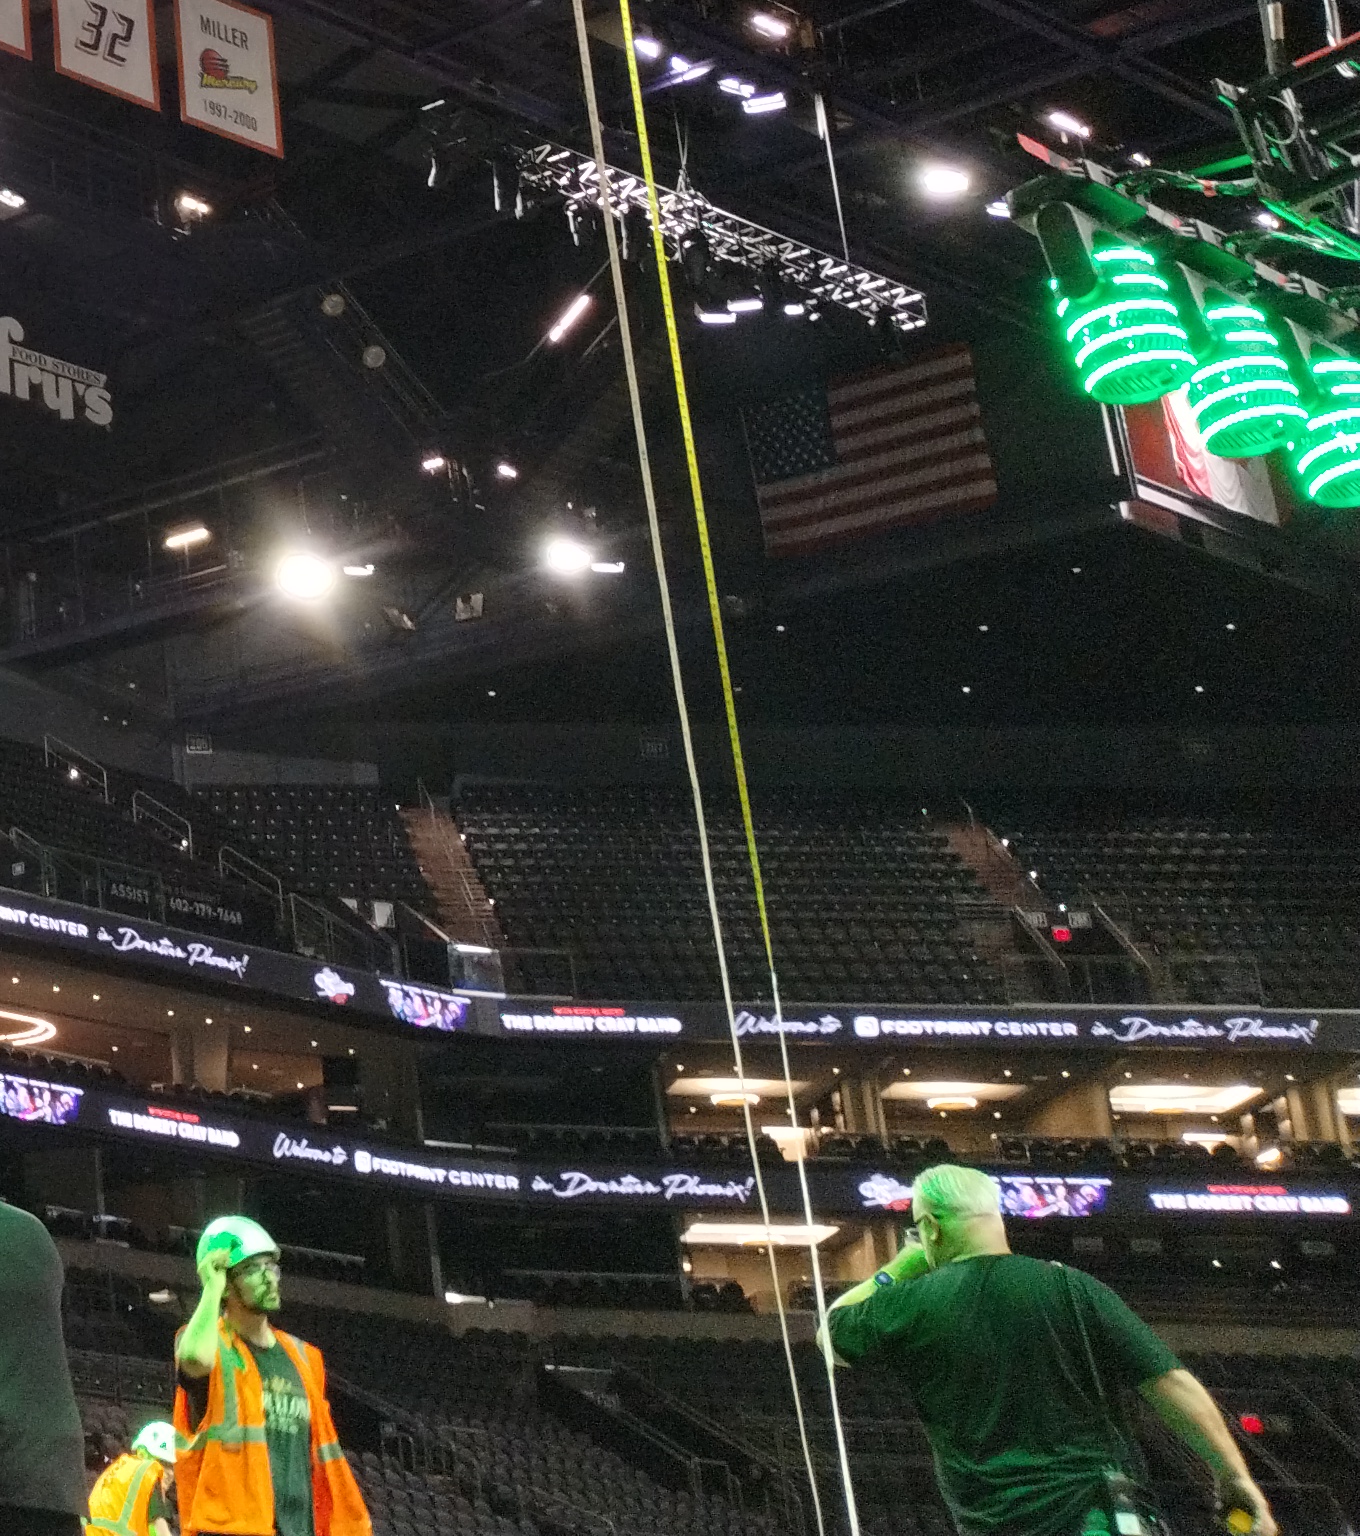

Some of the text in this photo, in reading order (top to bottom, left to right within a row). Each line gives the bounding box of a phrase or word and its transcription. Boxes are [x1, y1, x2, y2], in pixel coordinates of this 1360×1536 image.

[200, 15, 249, 50] MILLER
[203, 99, 258, 132] 1997-2000
[11, 345, 102, 385] FOOD STORES
[29, 913, 89, 938] CENTER
[501, 1013, 534, 1031] THE
[880, 1019, 992, 1036] FOOTPRINT
[994, 1020, 1079, 1036] CENTER
[371, 1156, 448, 1183] FOOTPRINT
[448, 1168, 519, 1191] CENTER
